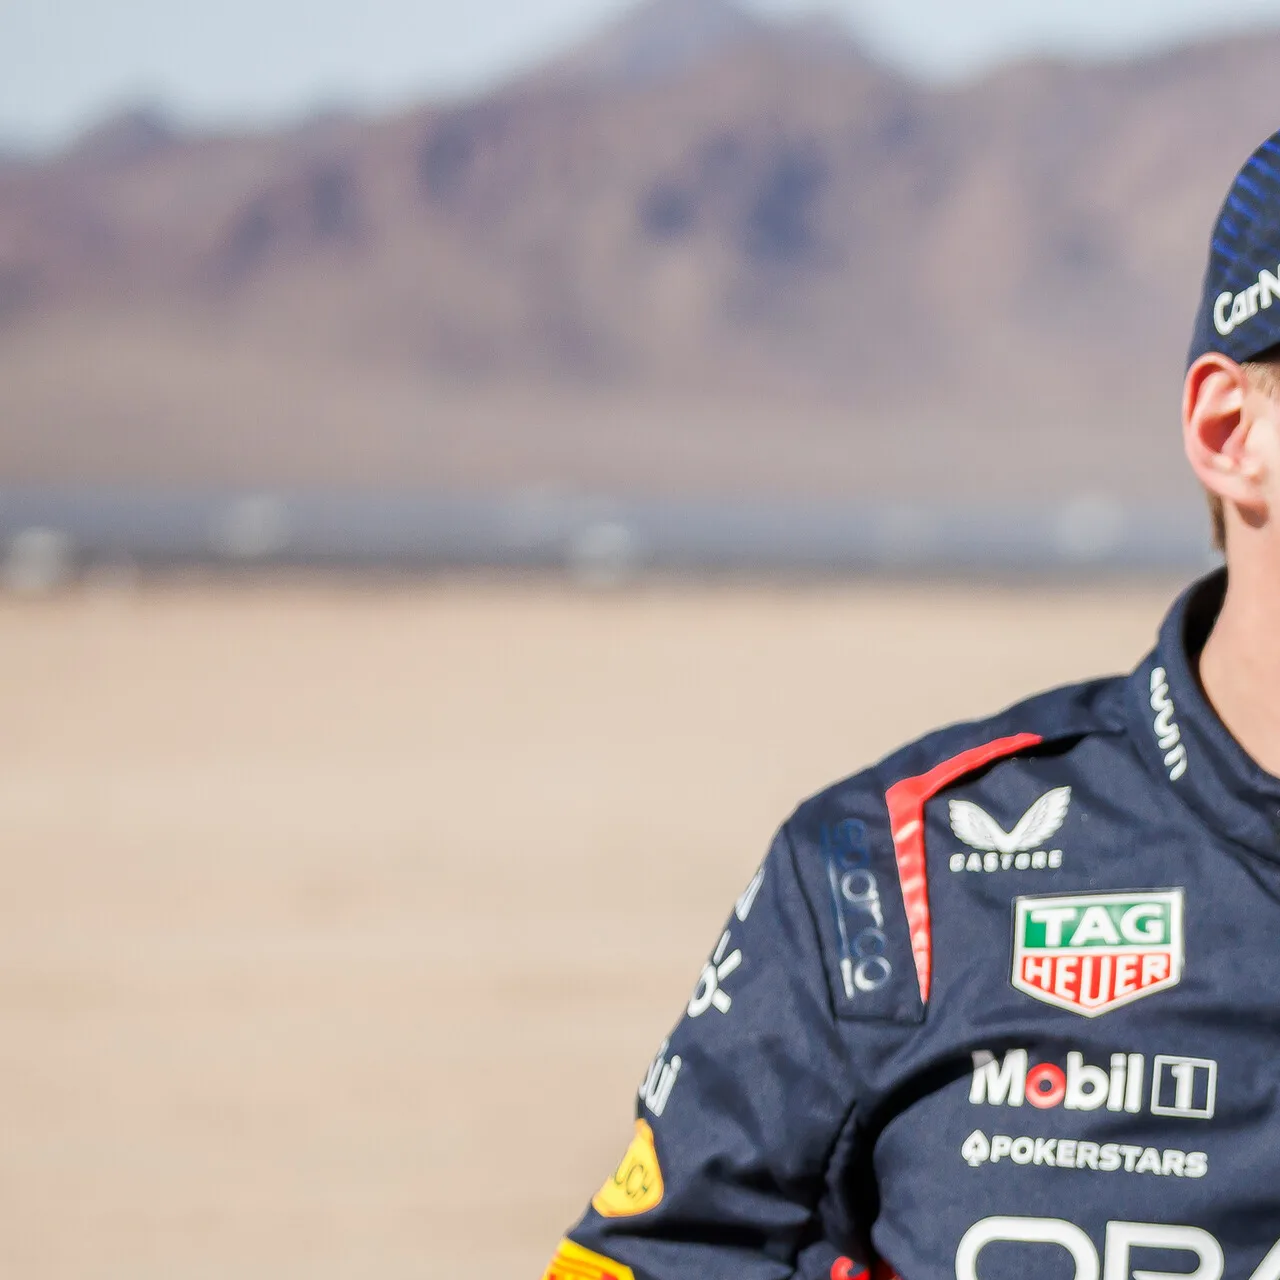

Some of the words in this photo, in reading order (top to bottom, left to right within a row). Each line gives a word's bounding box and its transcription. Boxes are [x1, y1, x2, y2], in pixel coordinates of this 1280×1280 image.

[949, 849, 1063, 872] CASTORE
[1026, 905, 1168, 947] TAG
[1022, 953, 1171, 1008] HEUER
[969, 1050, 1143, 1112] Mobil
[990, 1135, 1209, 1178] POKERSTARS
